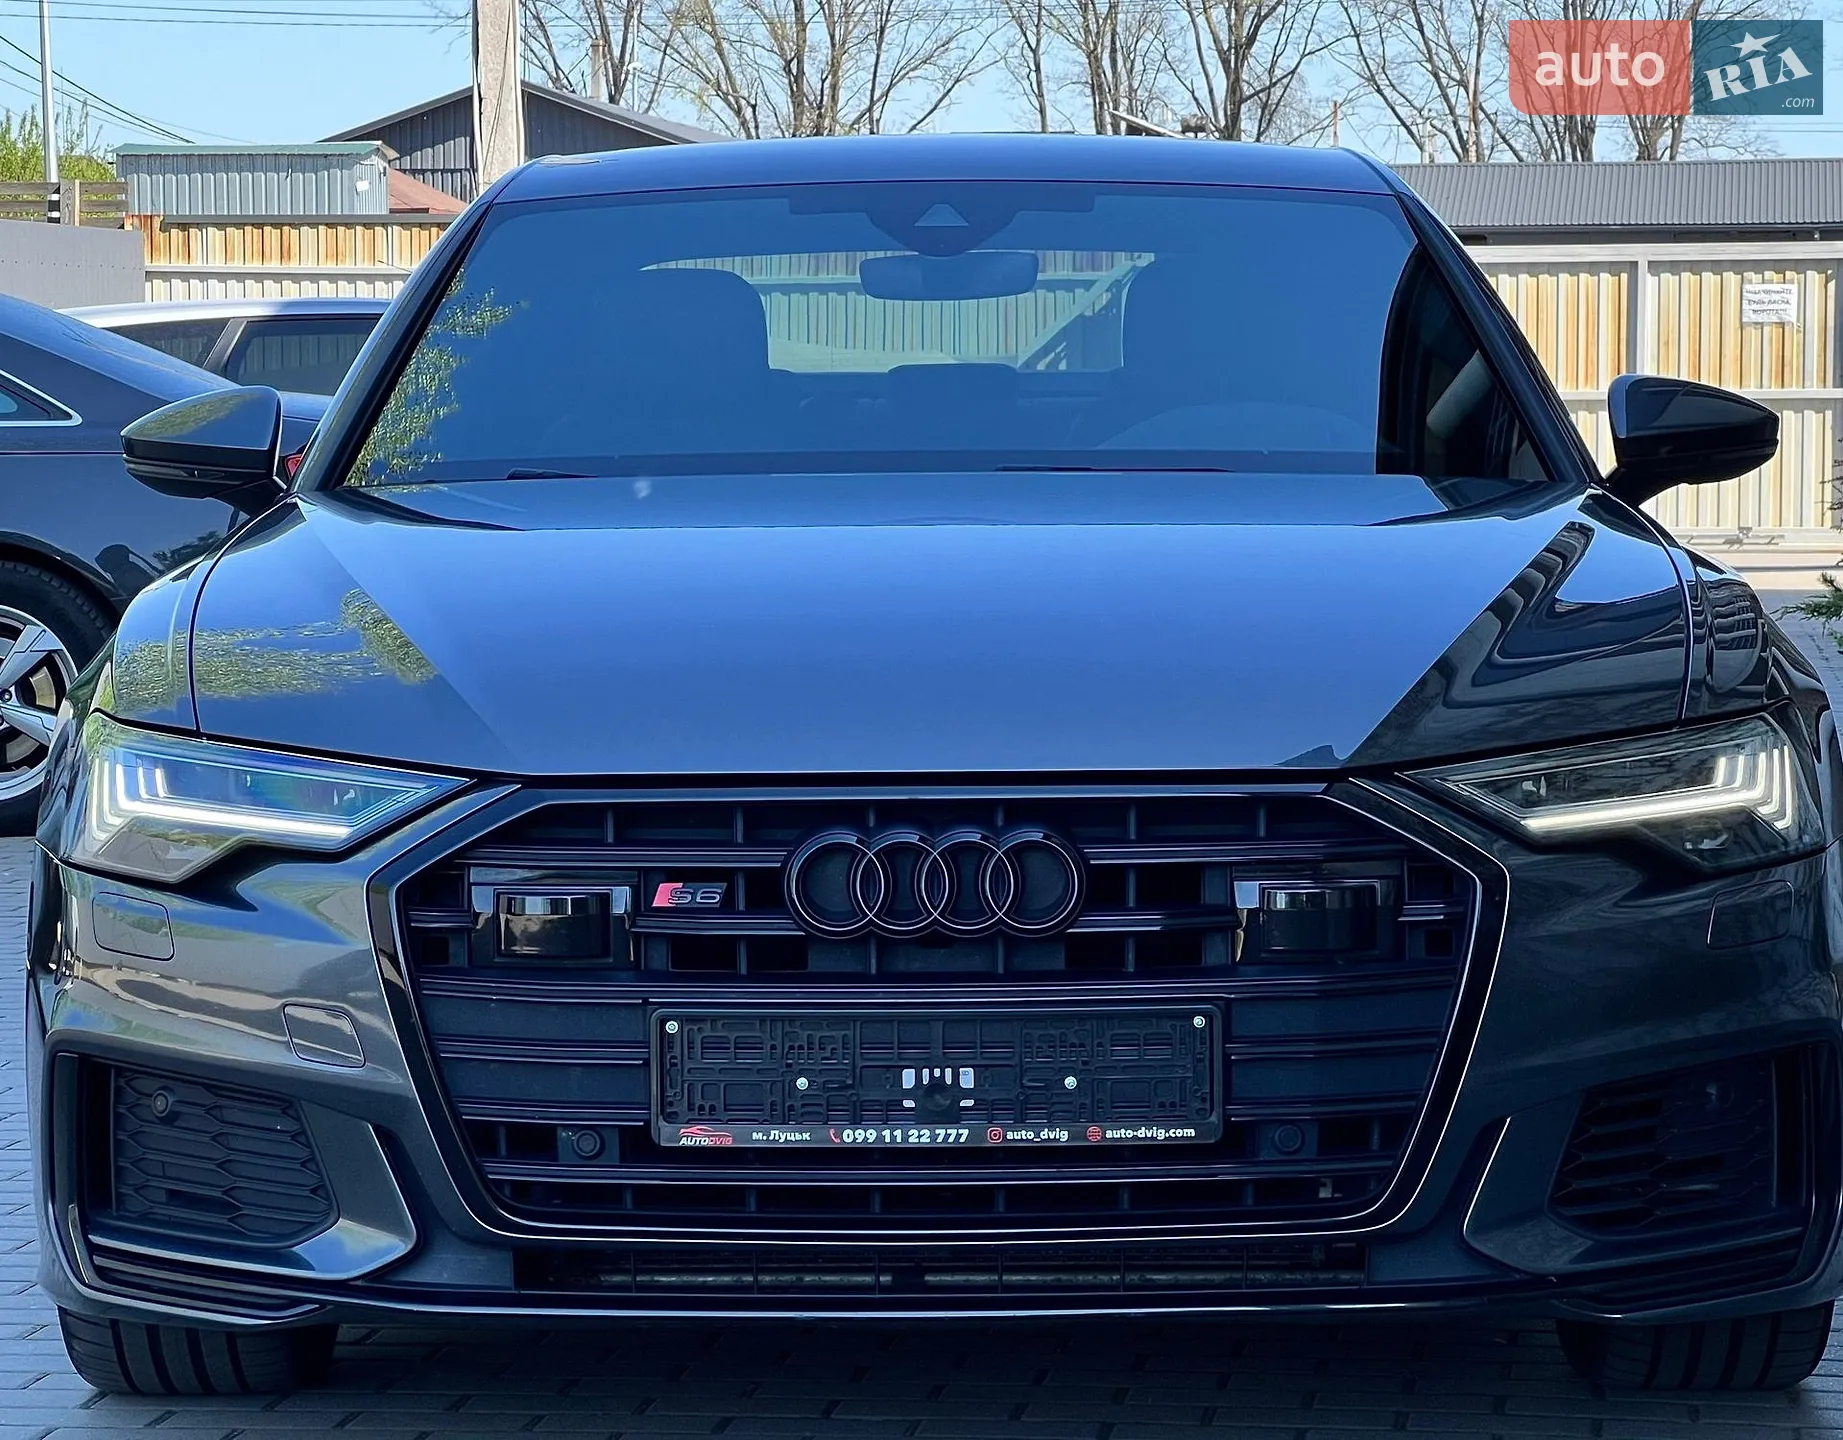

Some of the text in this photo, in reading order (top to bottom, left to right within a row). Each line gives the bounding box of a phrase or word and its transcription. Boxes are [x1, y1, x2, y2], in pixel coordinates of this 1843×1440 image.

[667, 888, 722, 903] S6
[769, 1129, 811, 1143] Луцьк
[842, 1128, 969, 1143] 099 11 22 777
[1006, 1127, 1069, 1142] auto_dvig
[1105, 1126, 1195, 1140] auto-dvig.com
